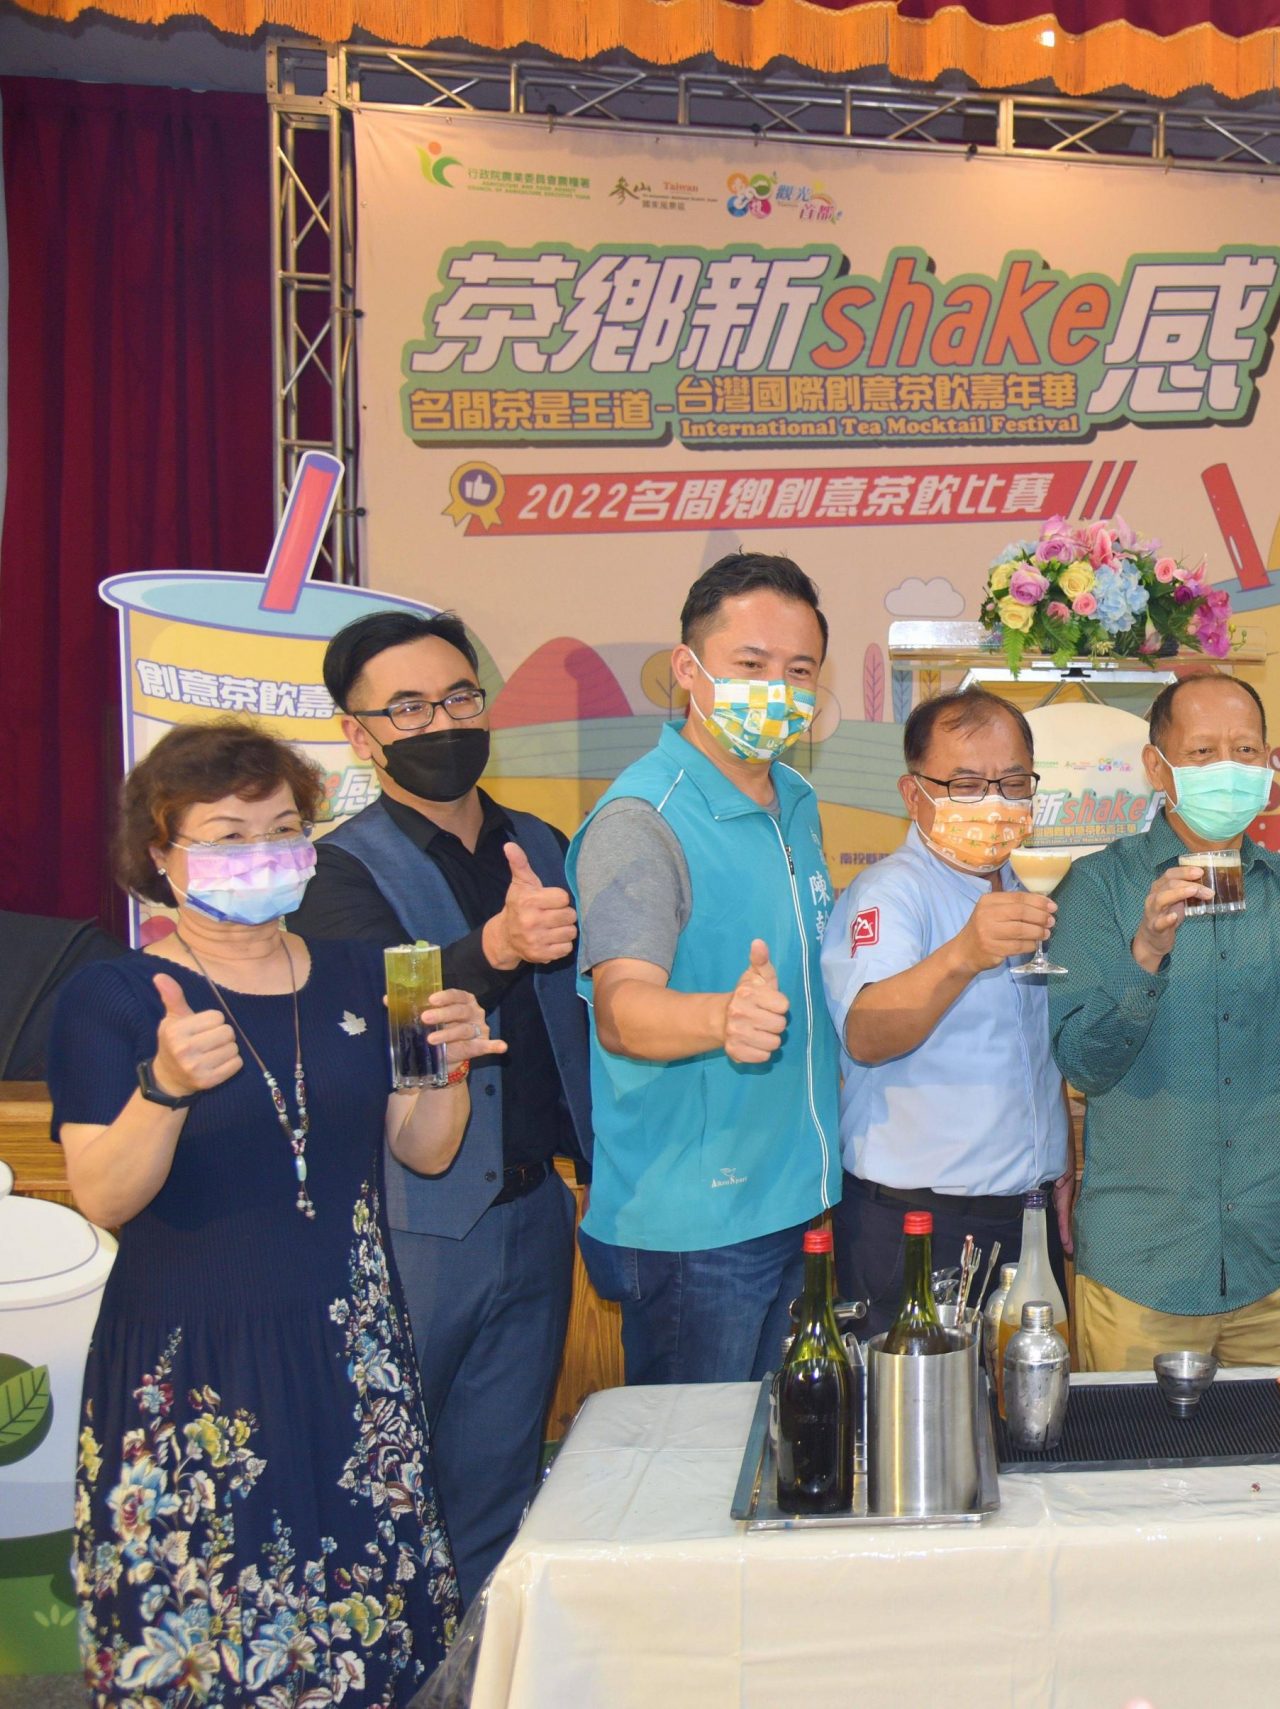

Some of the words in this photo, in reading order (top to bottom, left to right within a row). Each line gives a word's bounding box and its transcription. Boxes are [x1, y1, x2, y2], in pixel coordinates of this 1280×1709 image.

[663, 181, 699, 193] Taiwan
[410, 388, 652, 430] 名間茶是王道
[677, 374, 1076, 413] 台灣國際創意茶飲嘉年華
[681, 418, 837, 437] International
[842, 417, 882, 435] Tea
[888, 415, 986, 435] Mocktail
[991, 414, 1079, 434] Festival
[518, 472, 1054, 522] 2022名間鄉創意茶飲比賽
[137, 659, 344, 719] 創意茶飲嘉
